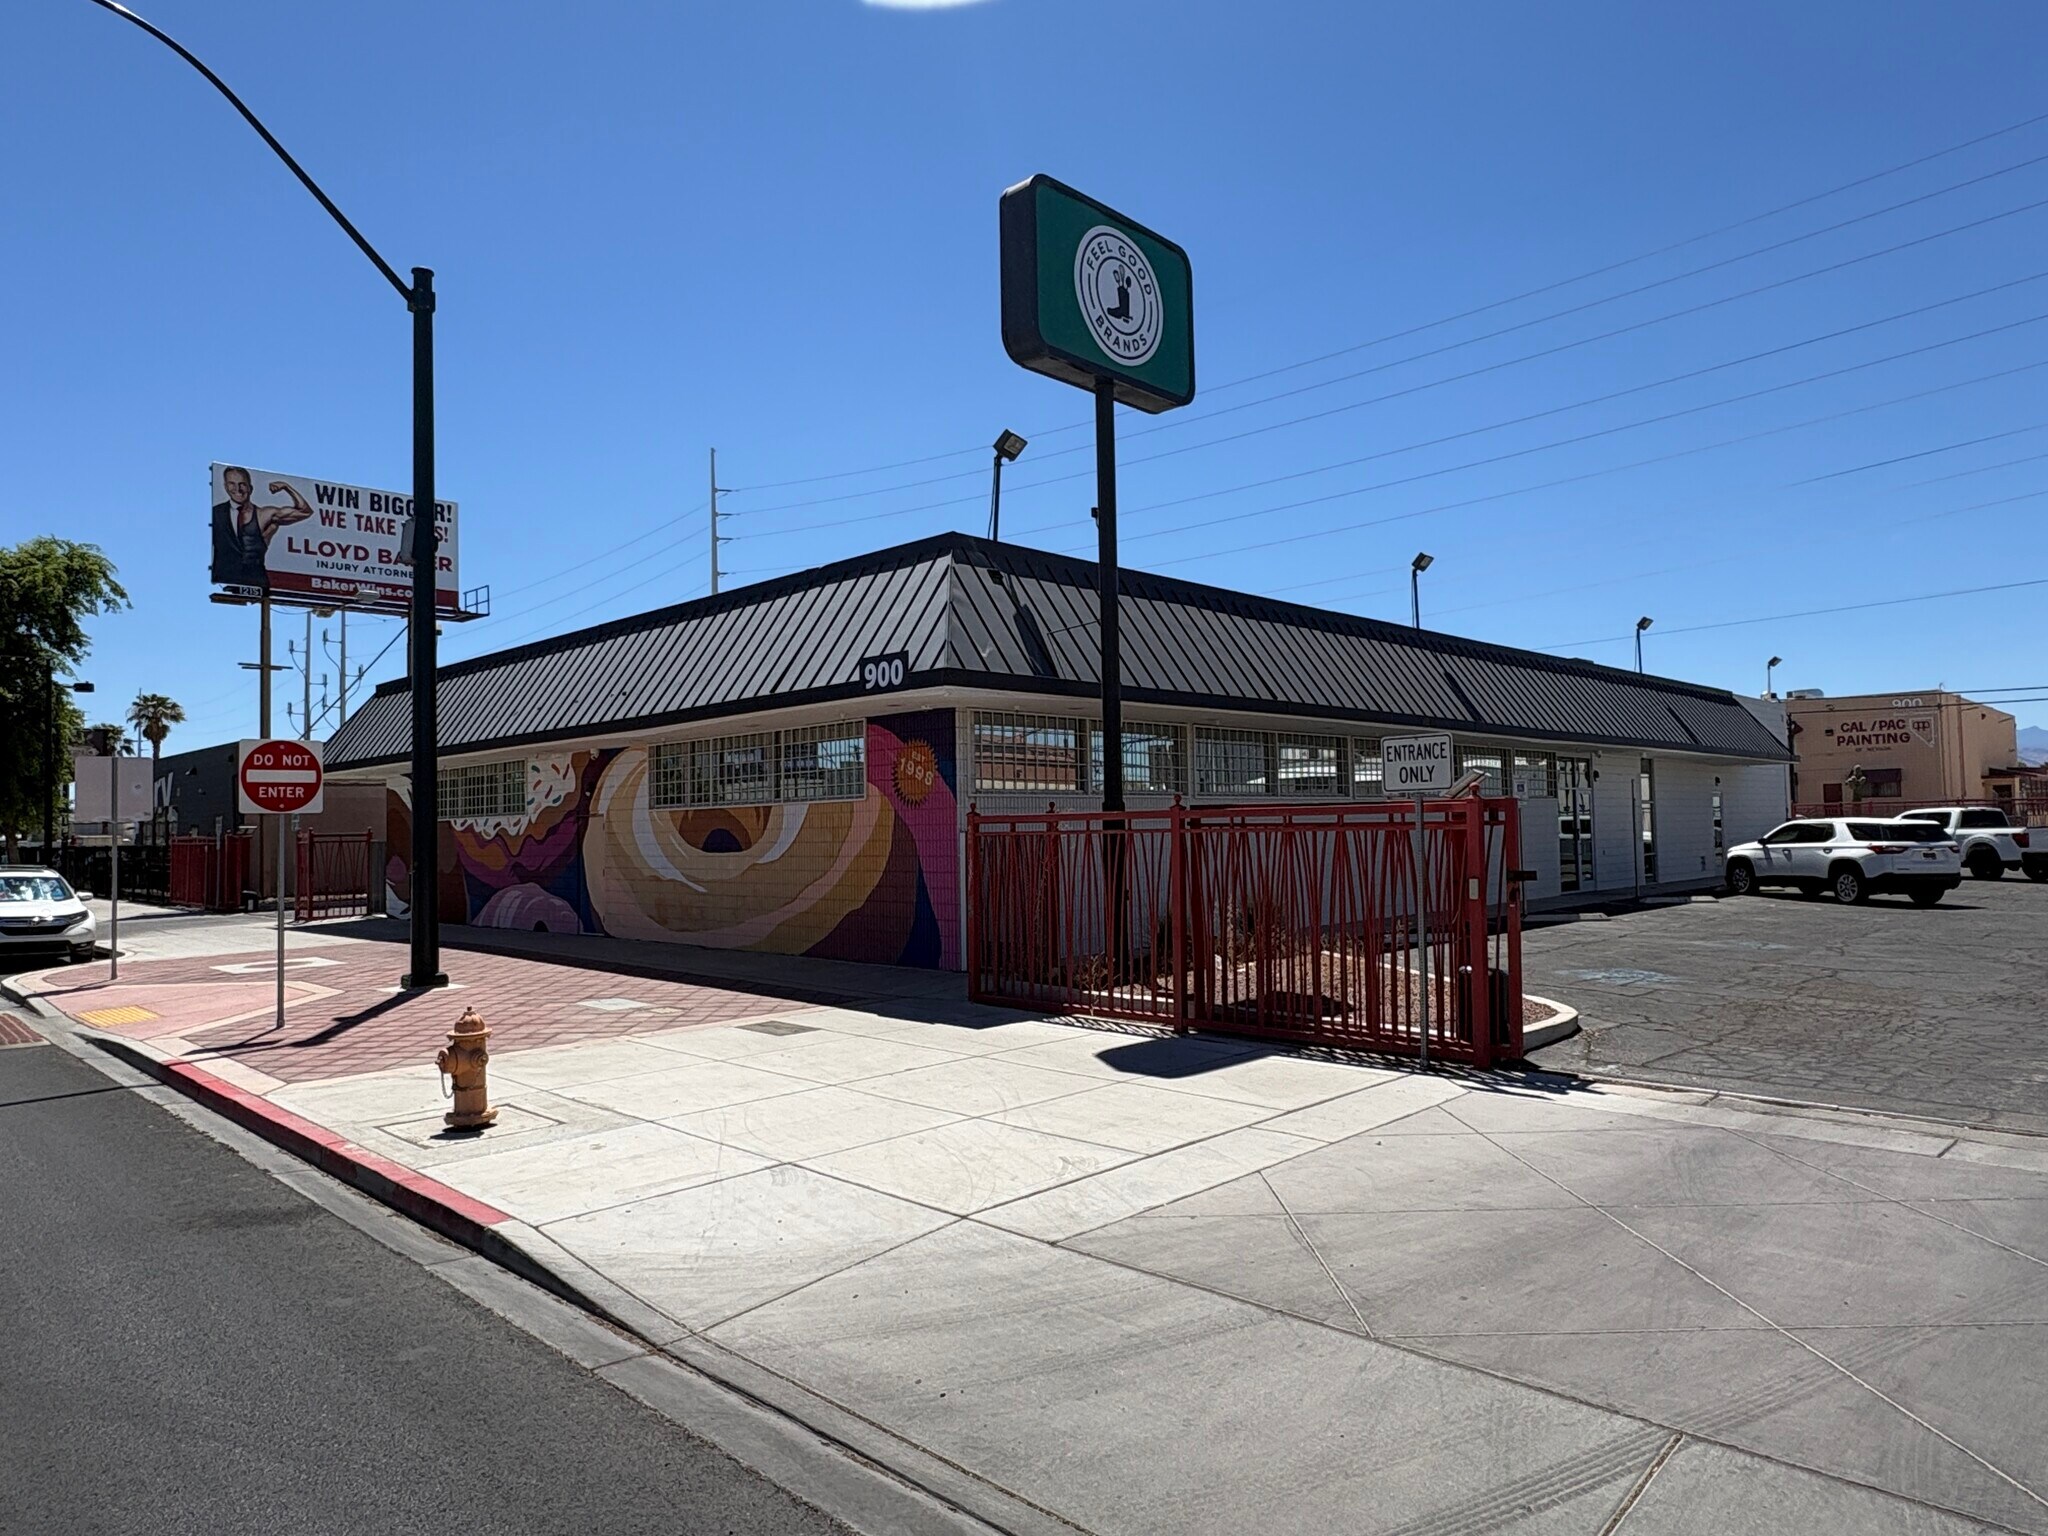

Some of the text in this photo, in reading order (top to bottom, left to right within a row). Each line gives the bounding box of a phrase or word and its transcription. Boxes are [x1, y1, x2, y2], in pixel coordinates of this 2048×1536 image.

[1086, 240, 1152, 295] FEEL GOOD
[1096, 315, 1147, 352] BRANDS
[314, 484, 452, 523] WIN BIGGR!
[319, 508, 397, 536] WE TAKE
[287, 537, 370, 561] LLOYD
[316, 560, 359, 572] INJURY
[864, 659, 904, 690] 900
[1386, 741, 1448, 762] ENTRANCE
[1837, 732, 1911, 747] PAINTING
[253, 754, 311, 766] DO NOT
[900, 757, 934, 786] 1998
[1400, 765, 1435, 784] ONLY
[259, 786, 304, 798] ENTER
